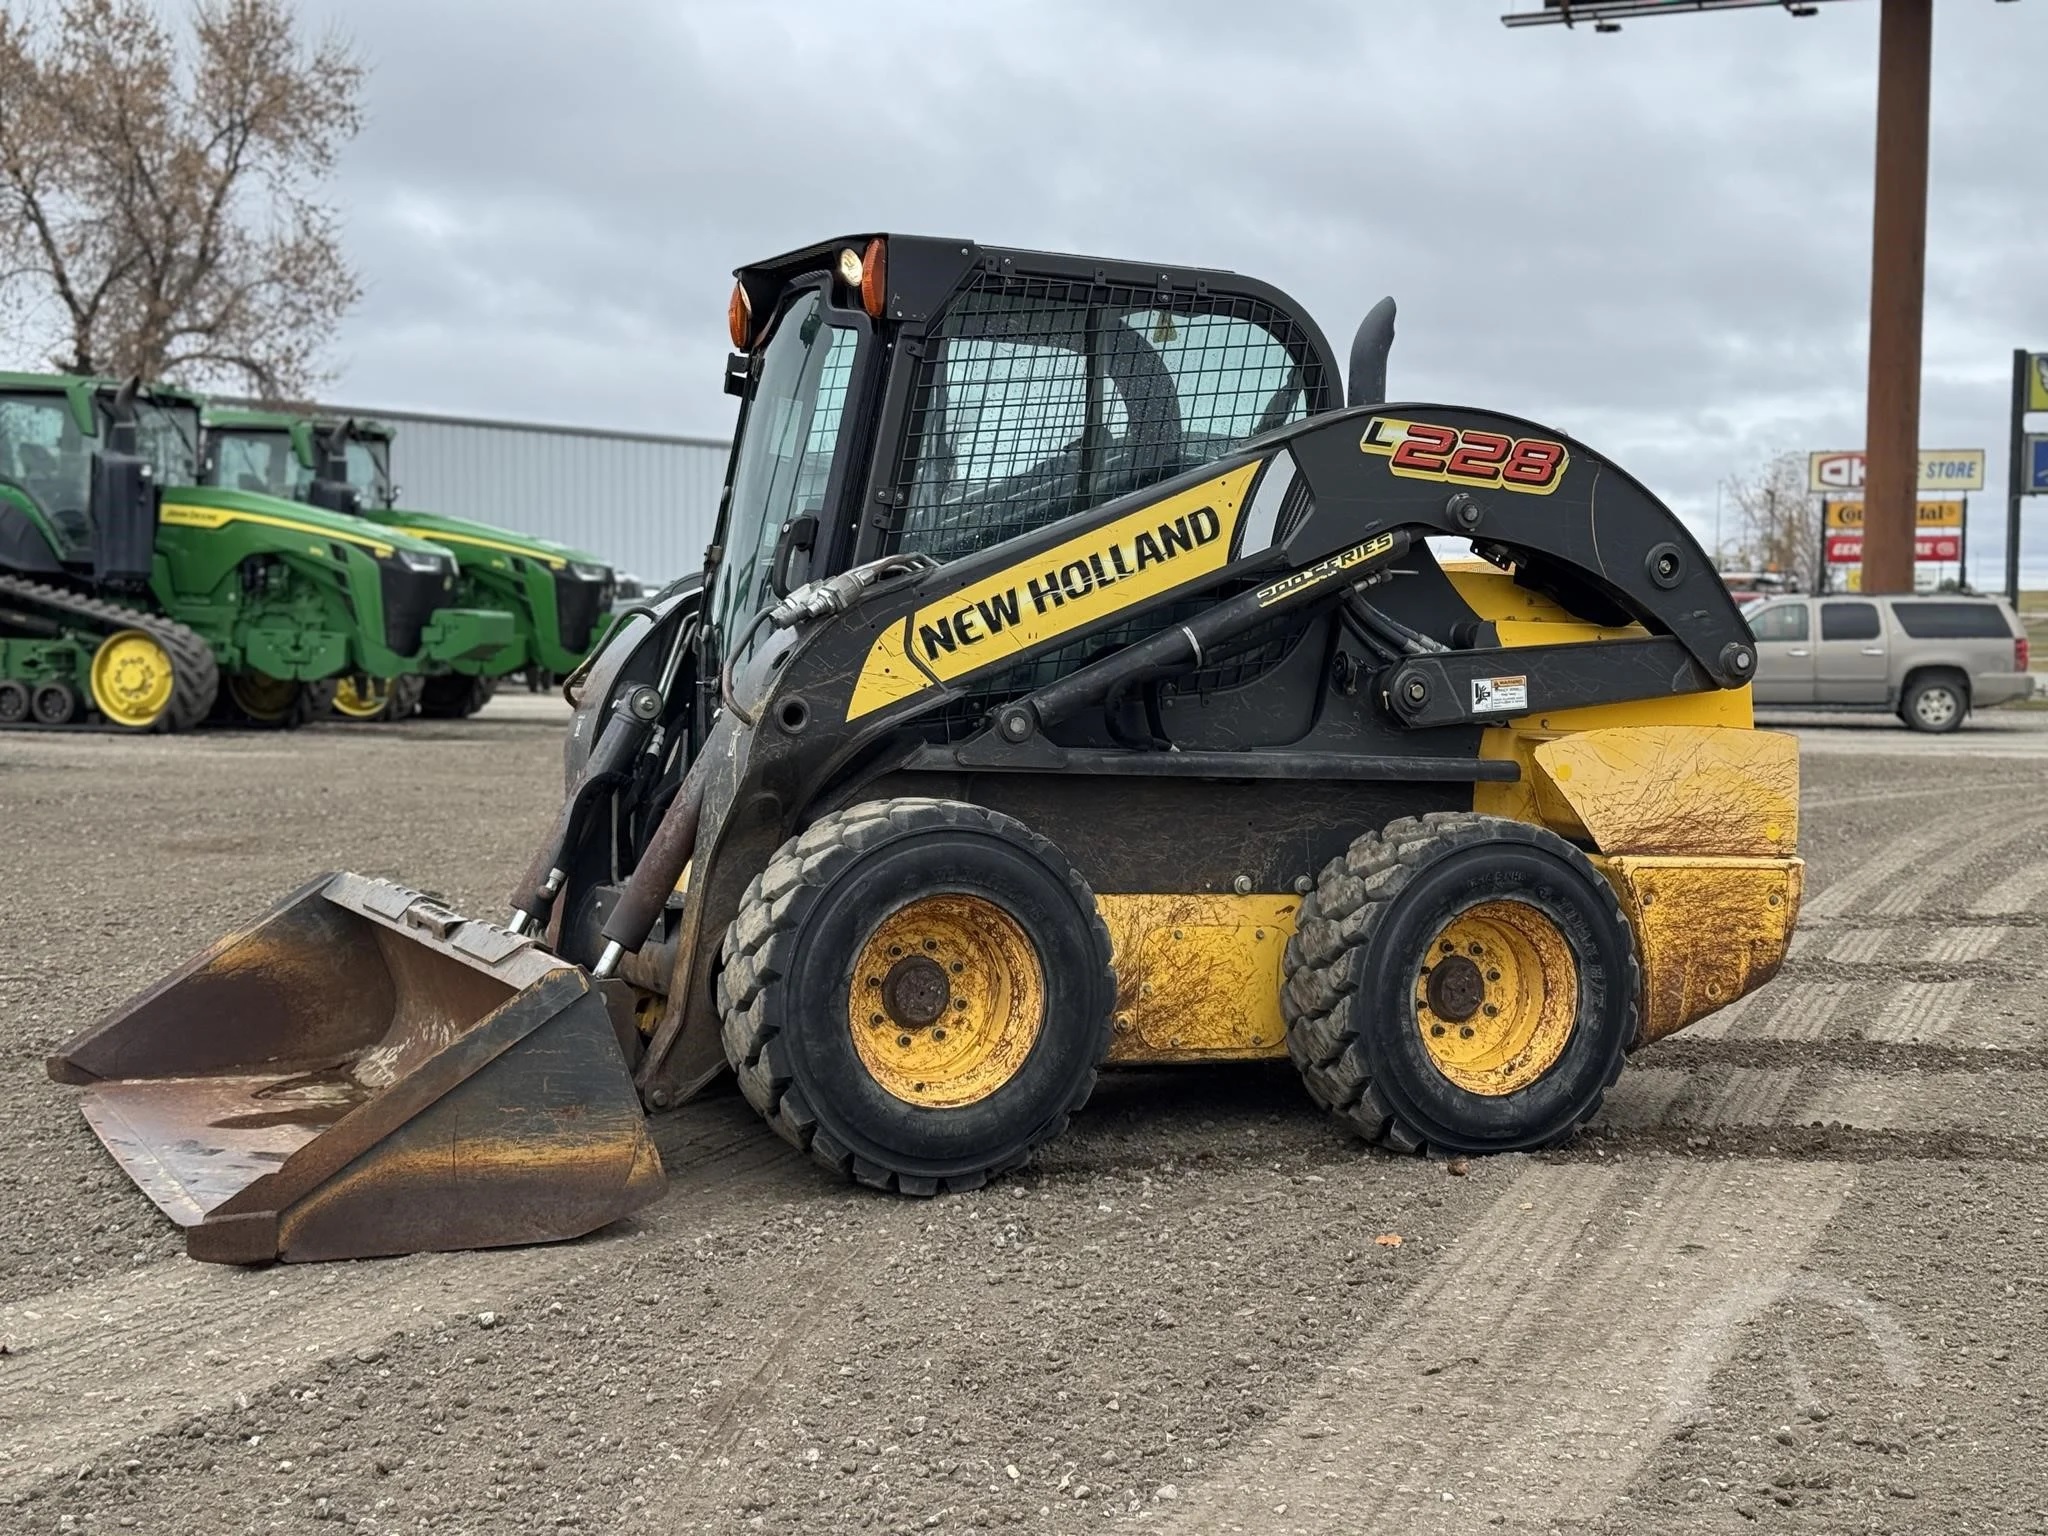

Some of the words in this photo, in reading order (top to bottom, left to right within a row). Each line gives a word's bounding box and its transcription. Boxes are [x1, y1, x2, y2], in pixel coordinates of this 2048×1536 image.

[1926, 460, 1976, 480] STORE
[918, 587, 1022, 662] NEW
[1027, 505, 1221, 616] HOLLAND
